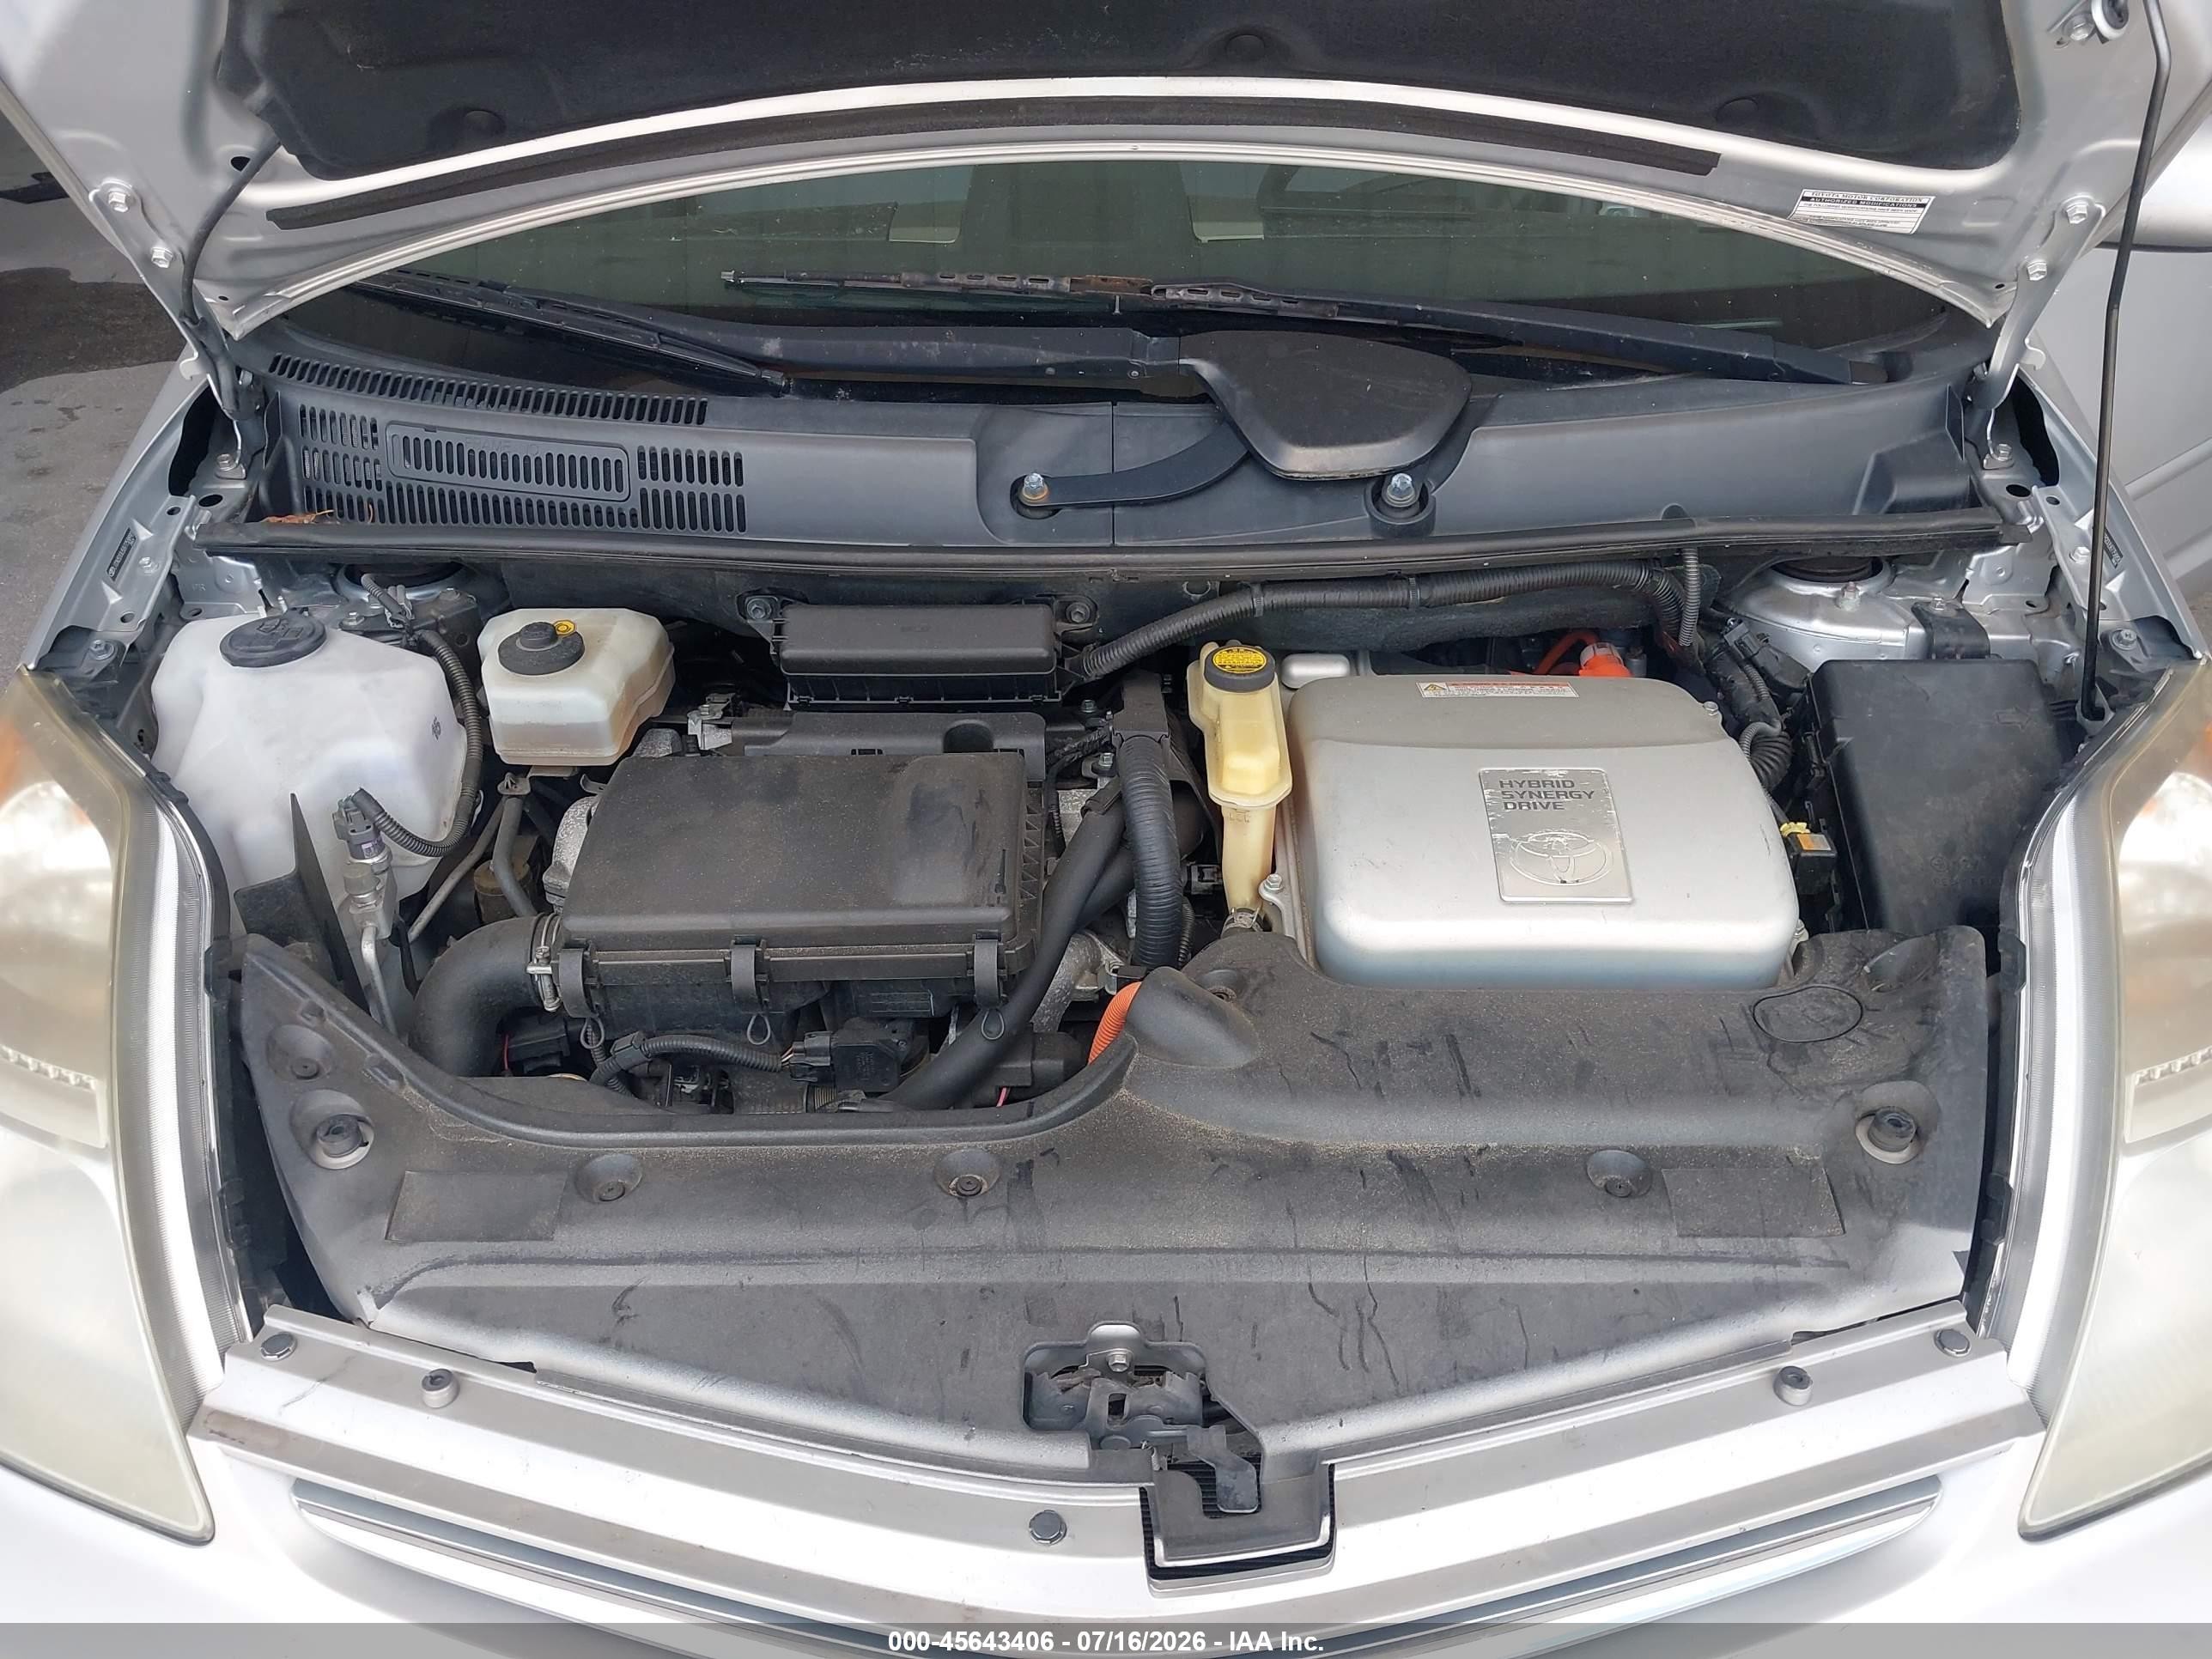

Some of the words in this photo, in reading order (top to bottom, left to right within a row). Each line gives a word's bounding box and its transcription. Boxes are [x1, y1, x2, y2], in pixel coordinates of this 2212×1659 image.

[1499, 780, 1575, 789] HYBRID
[1502, 790, 1595, 799] SYNERGY
[1504, 801, 1565, 811] DRIVE
